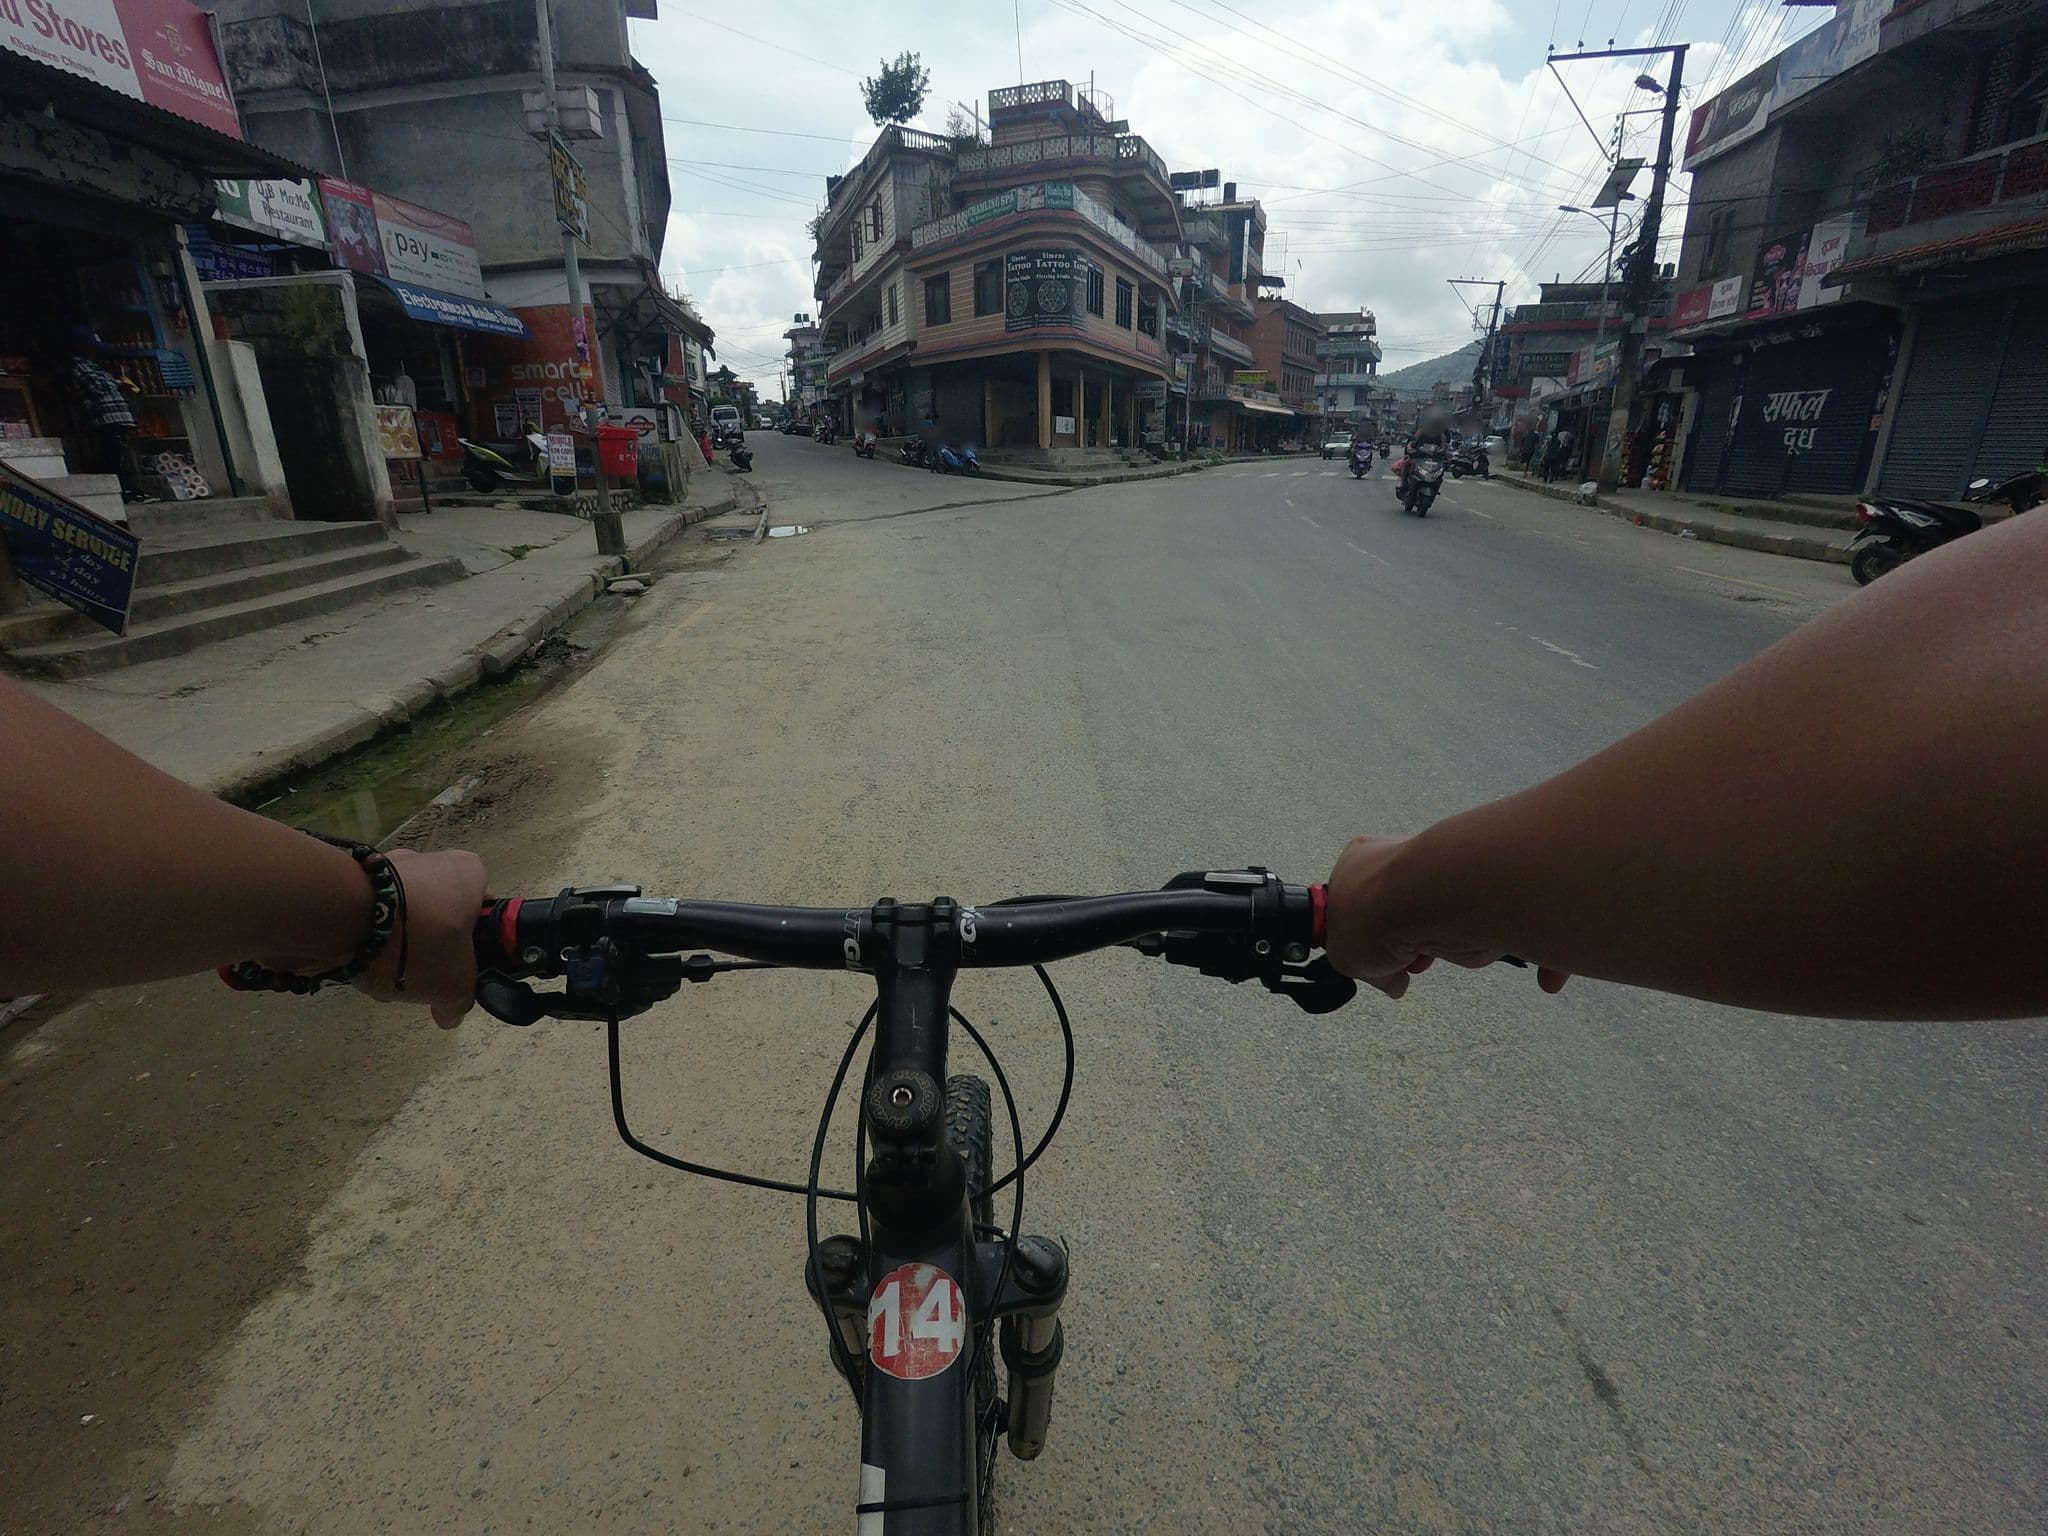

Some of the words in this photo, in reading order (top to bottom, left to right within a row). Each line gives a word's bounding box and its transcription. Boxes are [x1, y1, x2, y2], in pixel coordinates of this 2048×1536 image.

[25, 0, 131, 70] Stores
[142, 49, 176, 80] San
[173, 62, 228, 101] Miguel
[262, 201, 316, 231] Restaurant
[1035, 258, 1071, 269] TATTOO
[512, 358, 581, 380] smart
[542, 381, 584, 402] cell
[1784, 427, 1818, 455] दूध
[51, 518, 132, 573] SERVICE
[869, 1278, 966, 1358] 14
